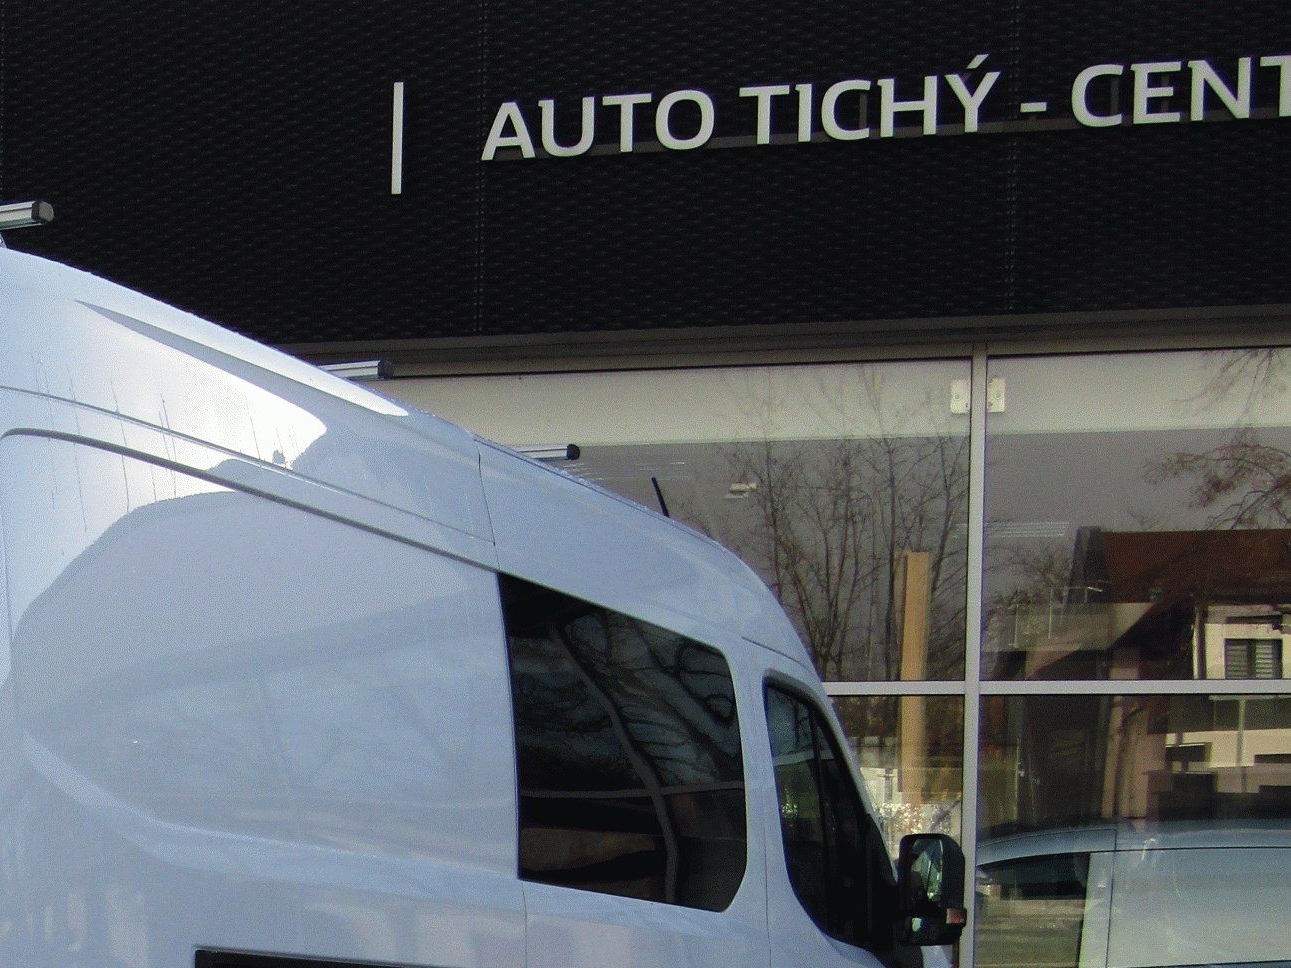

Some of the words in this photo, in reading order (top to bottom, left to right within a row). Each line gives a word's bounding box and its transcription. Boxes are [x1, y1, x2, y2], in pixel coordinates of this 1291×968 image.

[481, 88, 716, 161] AUTO
[738, 53, 1002, 144] TICHÝ
[1070, 54, 1291, 128] CENT
